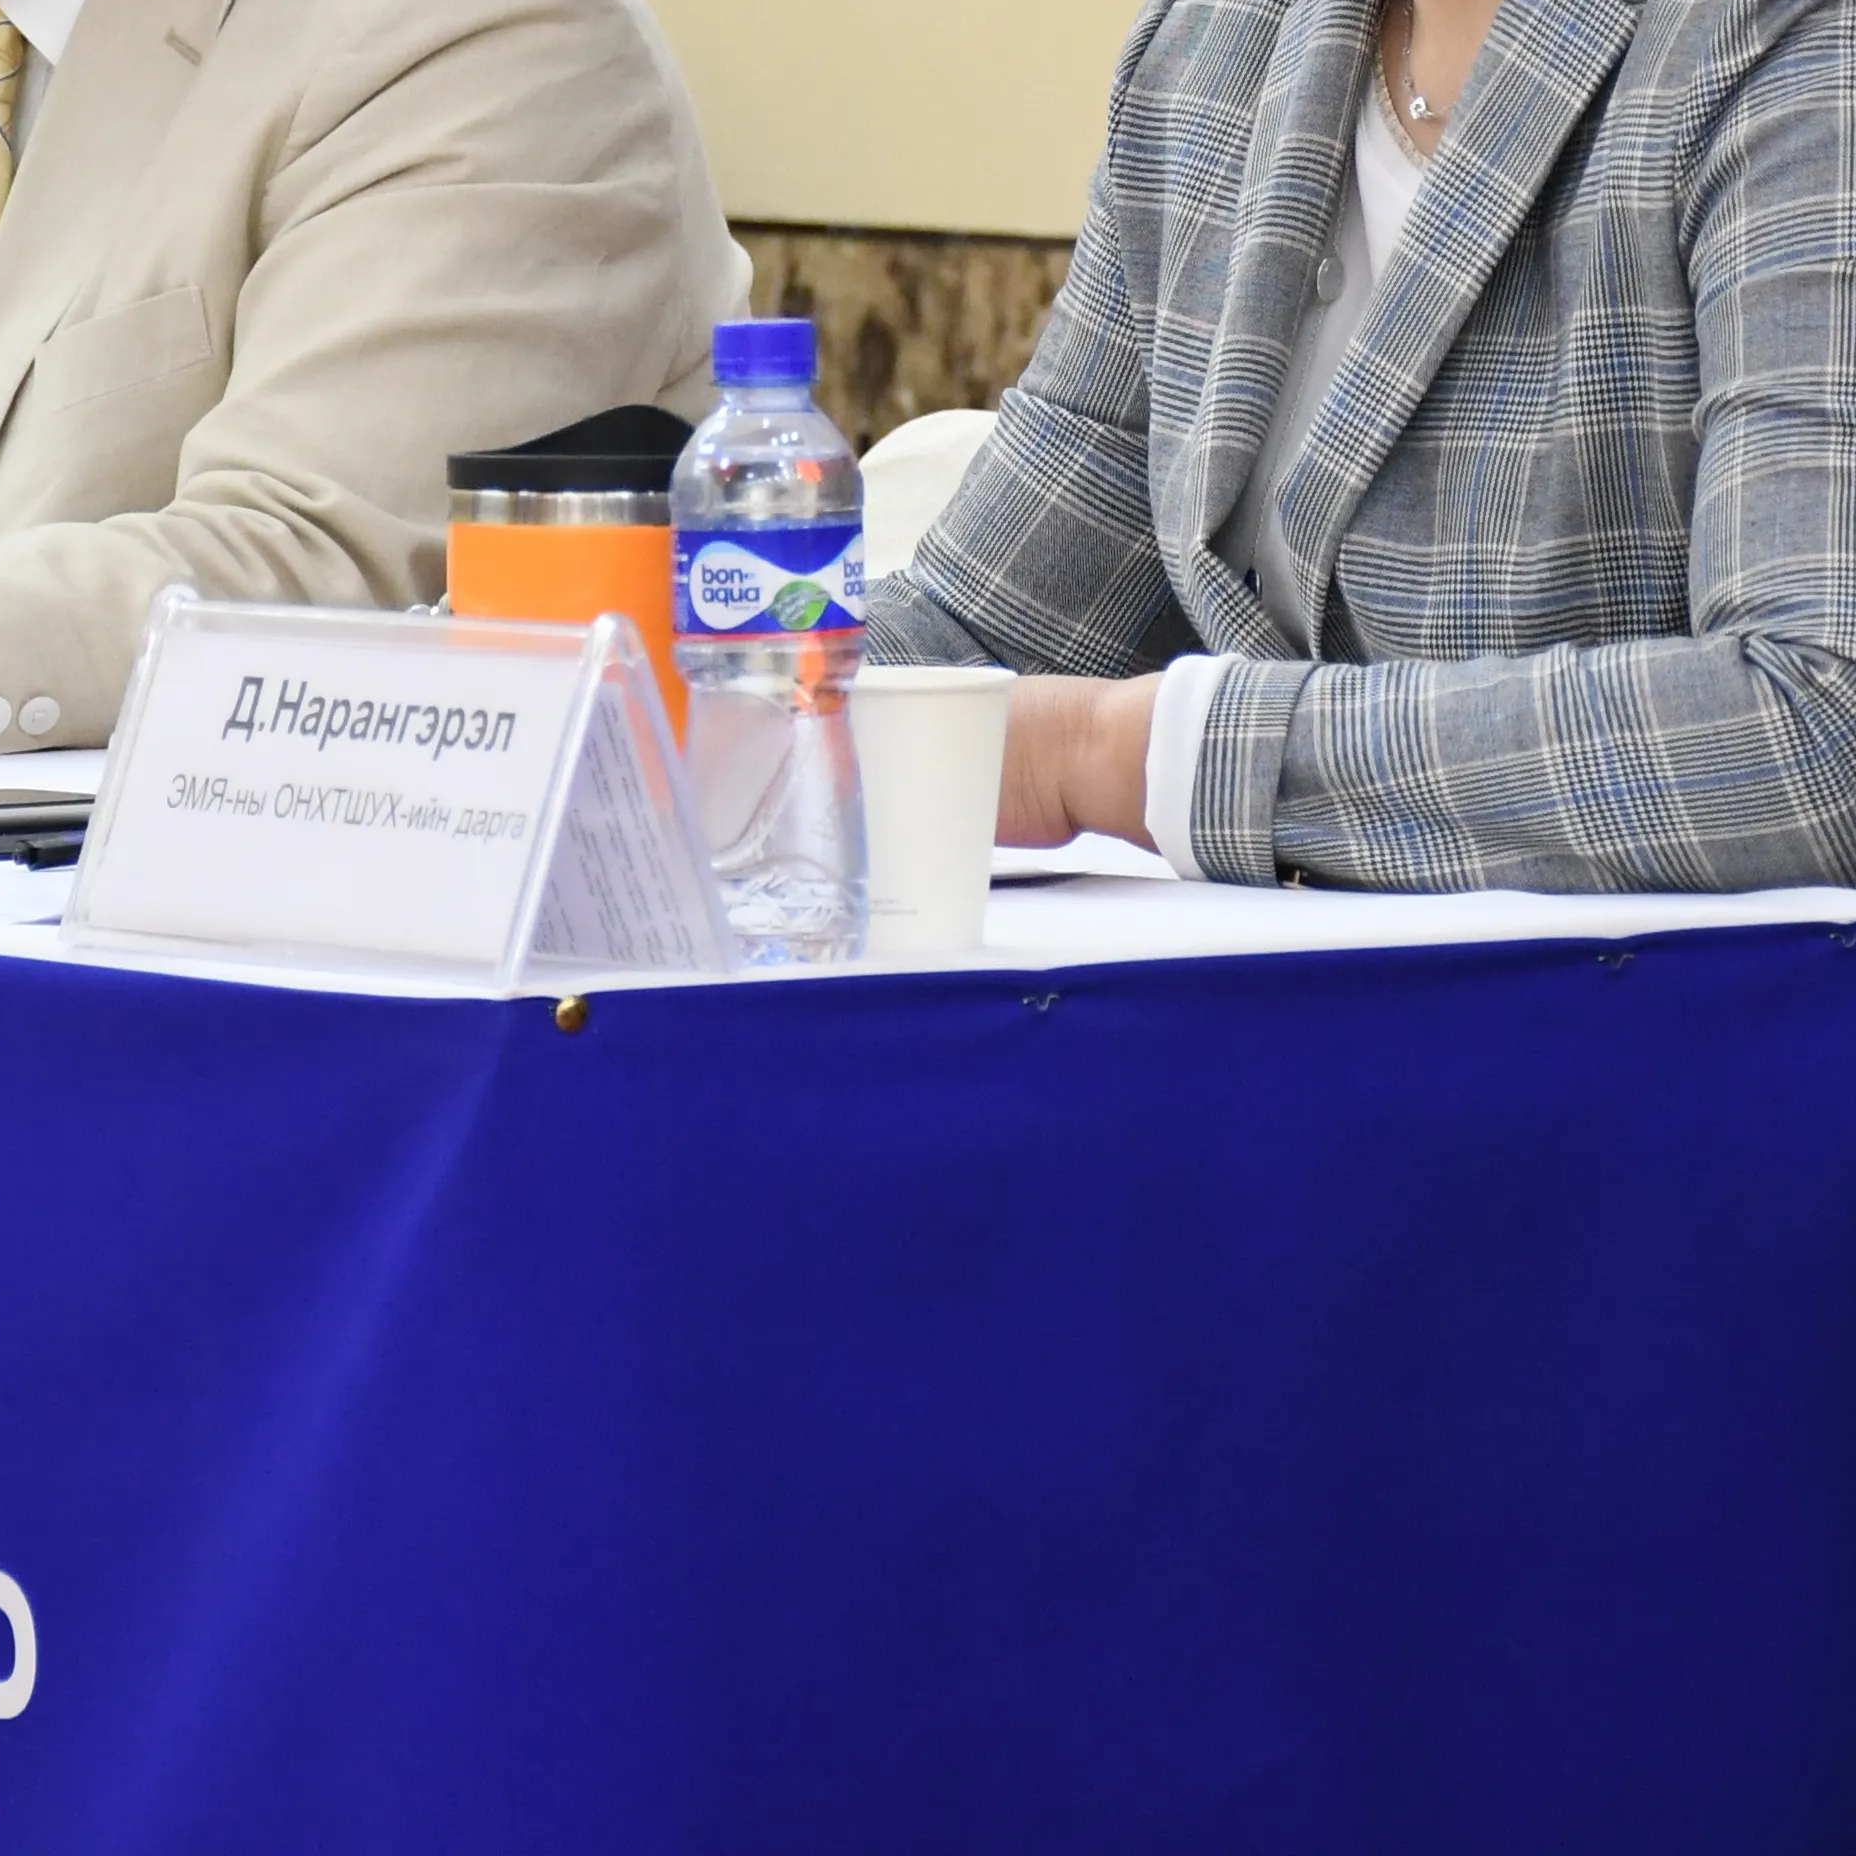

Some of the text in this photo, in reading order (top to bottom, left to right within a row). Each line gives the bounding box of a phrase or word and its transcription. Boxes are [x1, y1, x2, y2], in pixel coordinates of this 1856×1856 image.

[702, 587, 761, 608] aqua
[221, 675, 517, 762] Д.Нарангэрэл
[166, 773, 266, 817] ЭМЯ-ны
[452, 807, 528, 844] дарга
